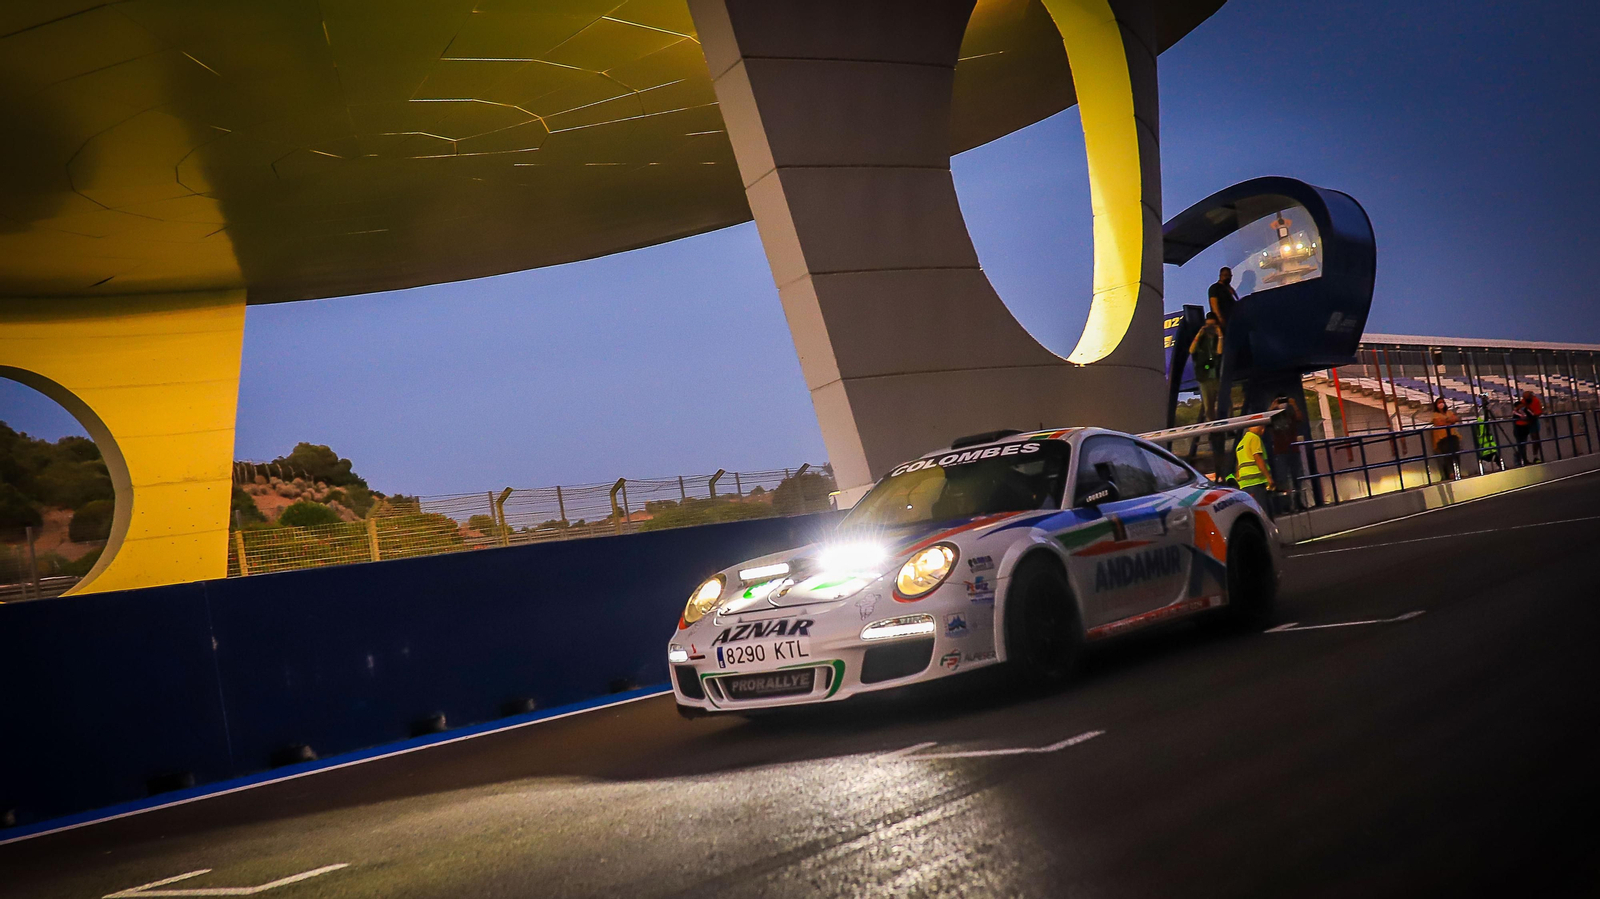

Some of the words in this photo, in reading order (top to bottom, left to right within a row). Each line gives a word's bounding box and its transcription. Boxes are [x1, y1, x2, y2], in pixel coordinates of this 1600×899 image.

[891, 442, 1041, 477] COLOMBES
[1095, 544, 1182, 593] ANDAMUR
[711, 619, 815, 648] AZNAR
[726, 644, 766, 665] 8290
[774, 640, 809, 660] KTL
[732, 672, 811, 692] PRORALLYE
